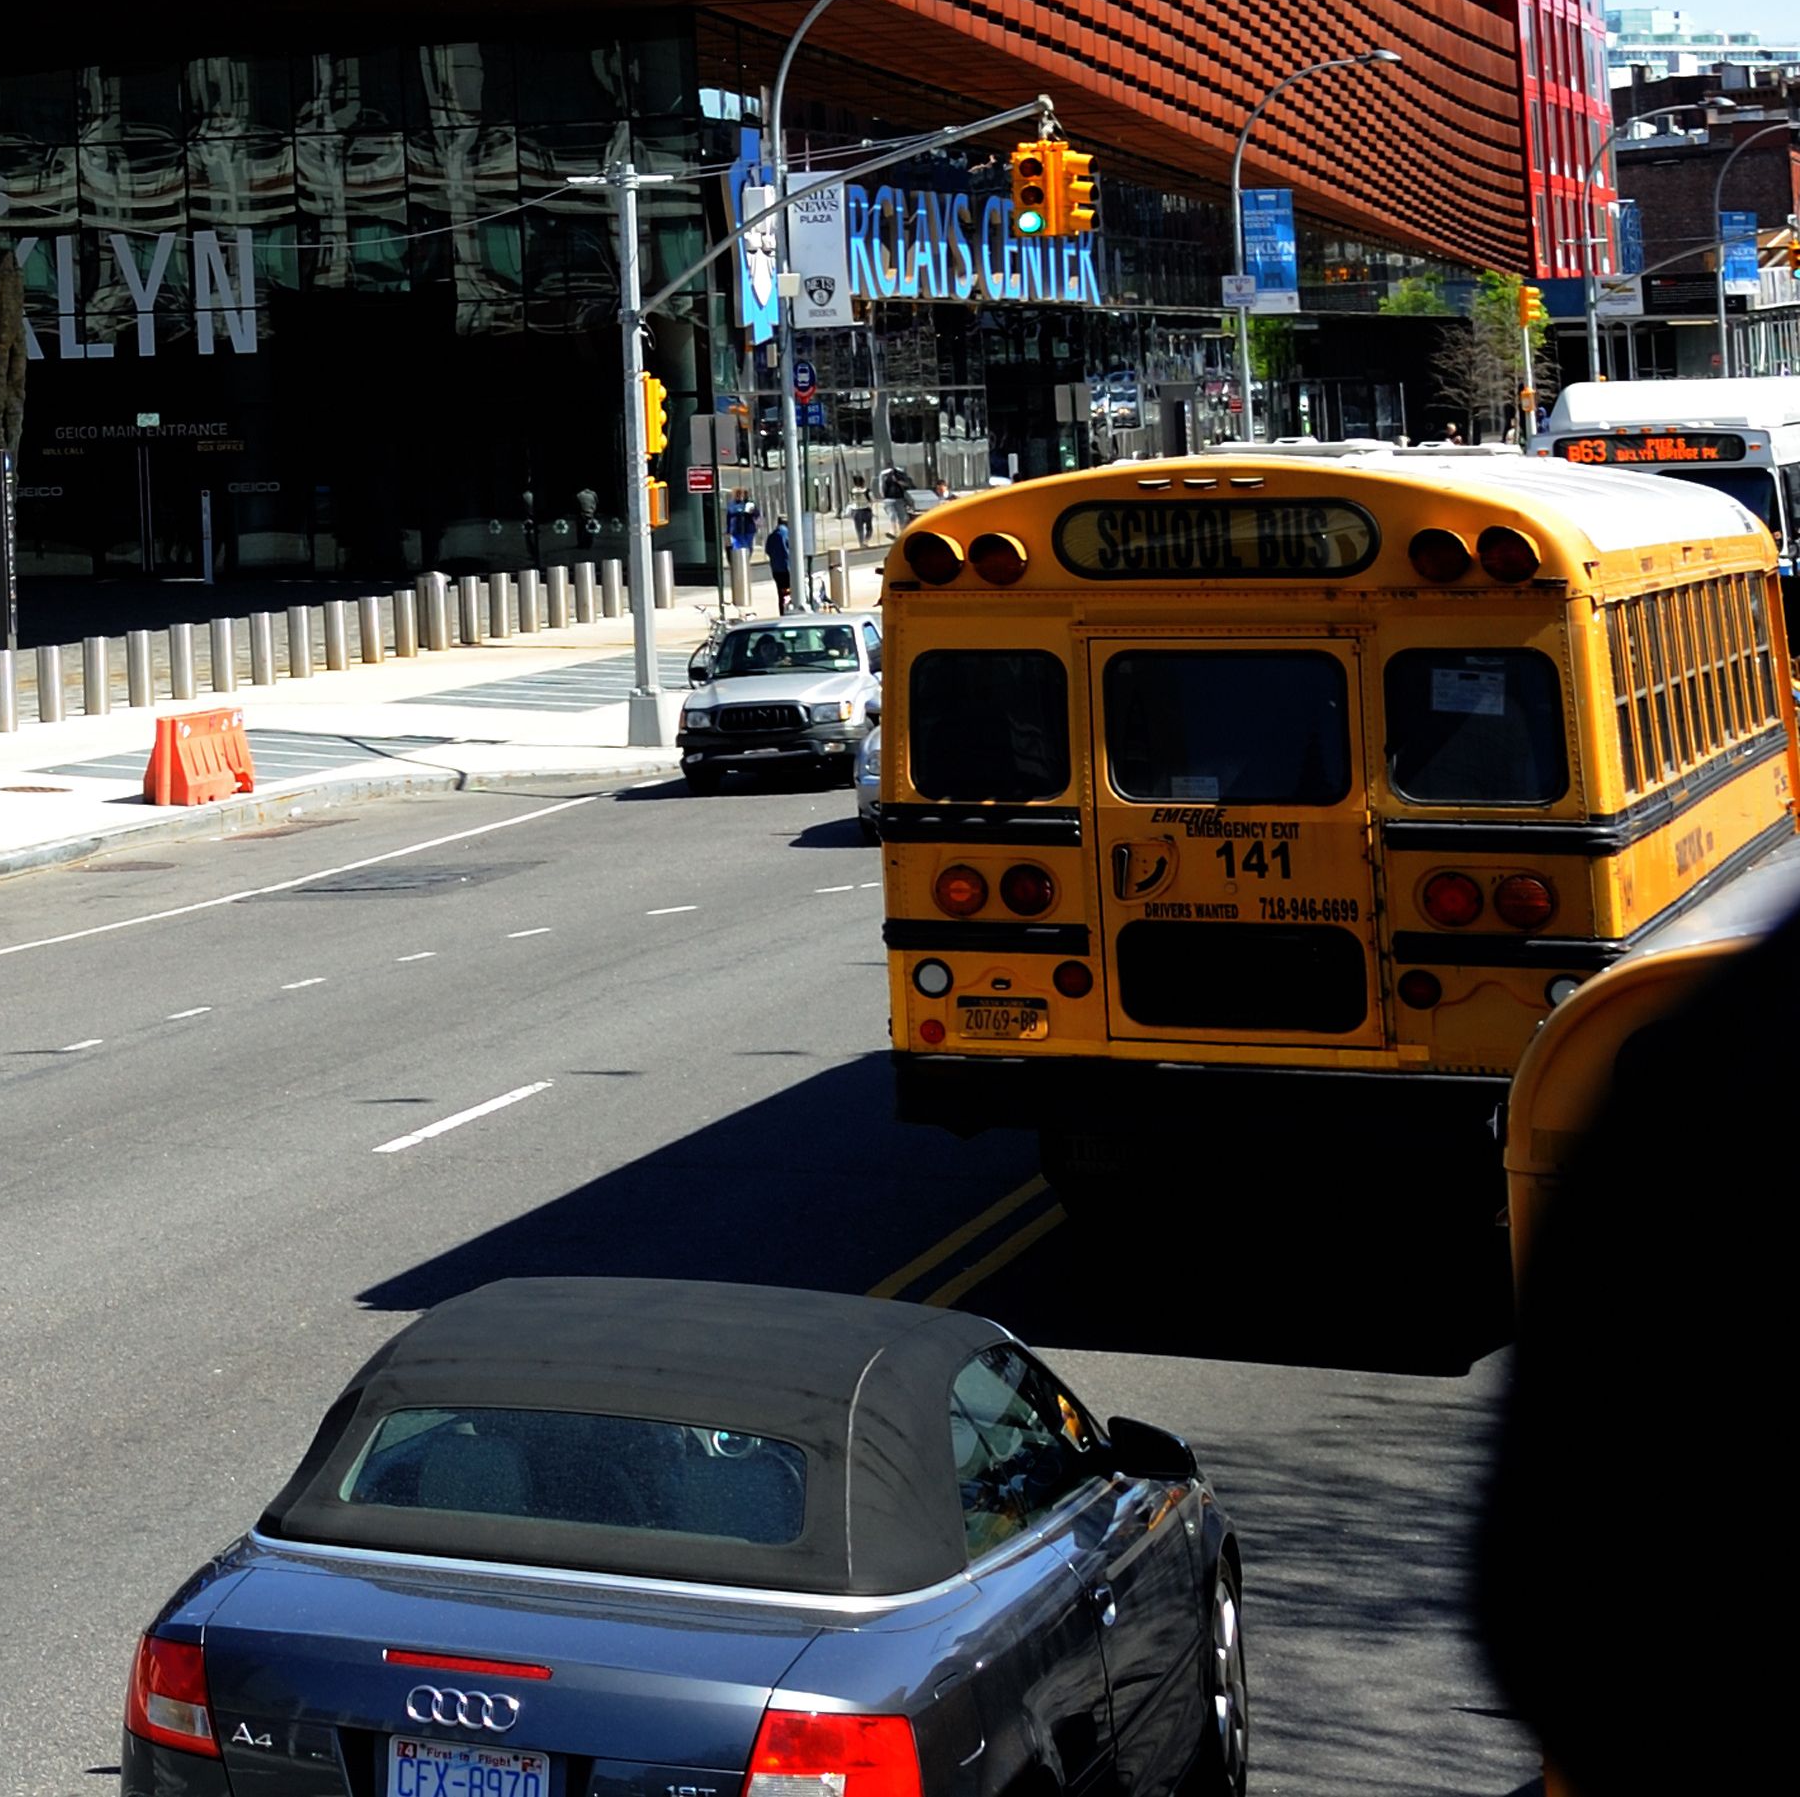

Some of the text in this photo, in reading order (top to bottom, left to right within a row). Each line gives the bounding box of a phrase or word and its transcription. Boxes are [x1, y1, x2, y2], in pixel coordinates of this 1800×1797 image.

[802, 188, 838, 201] AILY
[793, 201, 840, 214] NEWS
[800, 214, 833, 224] PLAZA
[1246, 241, 1295, 254] BKLYN
[54, 421, 229, 440] GEICO MAIN ENTRANCE
[1567, 439, 1607, 463] B63
[227, 481, 281, 493] GEICO
[1097, 507, 1330, 569] SCHOOL BUS
[1151, 807, 1228, 824] EMERGE
[1186, 821, 1300, 839] EMERGENCY EXIT
[1216, 840, 1291, 879] 141
[1144, 901, 1239, 920] DRIVERS WANTED
[1258, 896, 1360, 923] 718-946-6699
[231, 1722, 273, 1748] A4
[426, 1746, 453, 1760] First
[459, 1751, 470, 1762] in
[478, 1753, 512, 1766] Flight
